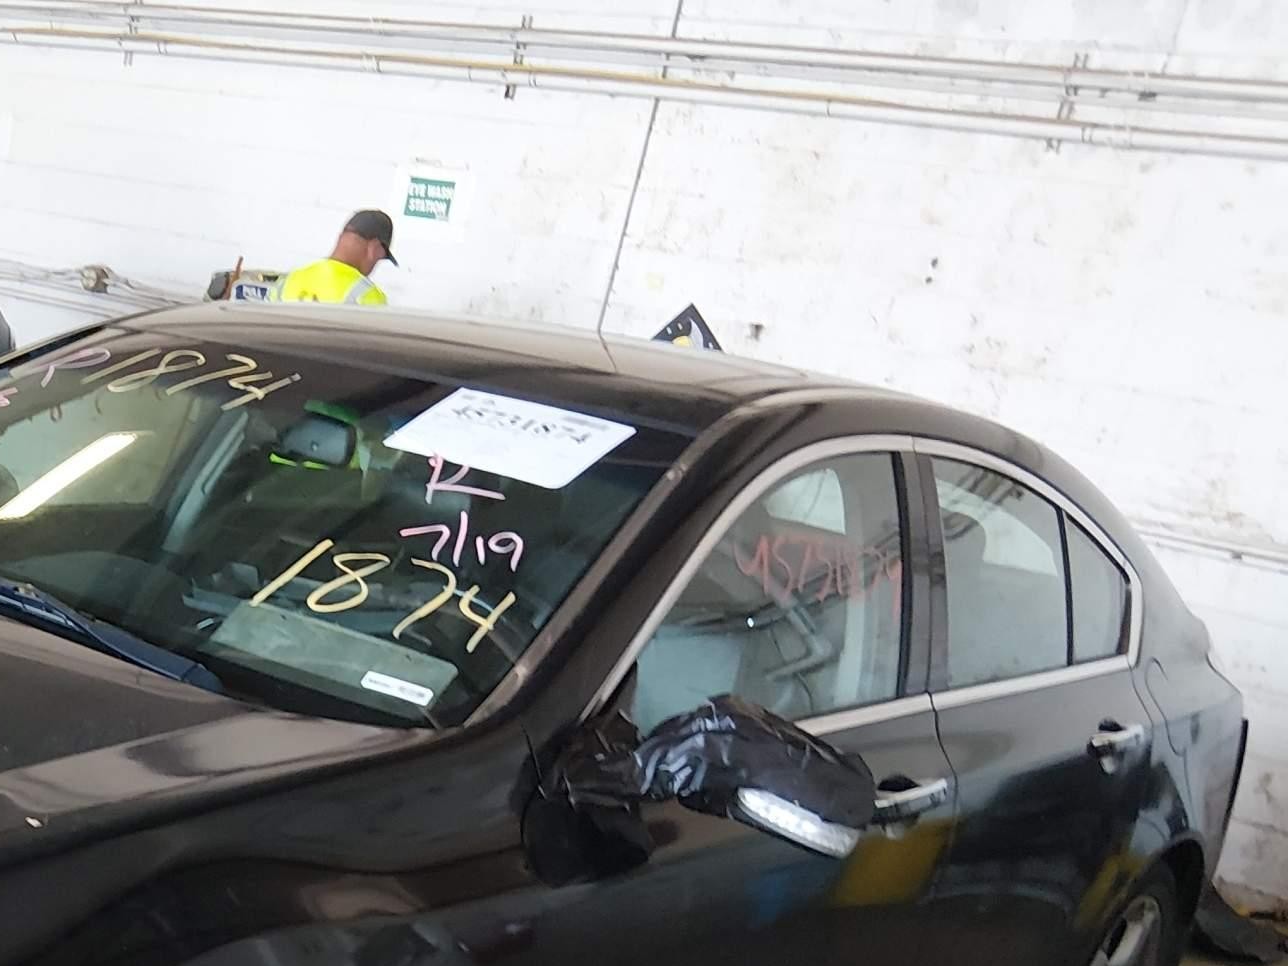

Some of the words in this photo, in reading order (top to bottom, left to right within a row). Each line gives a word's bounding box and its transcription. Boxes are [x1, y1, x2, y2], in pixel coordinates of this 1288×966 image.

[407, 198, 448, 217] STATION
[399, 511, 523, 572] 7/19
[249, 538, 516, 653] 1874
